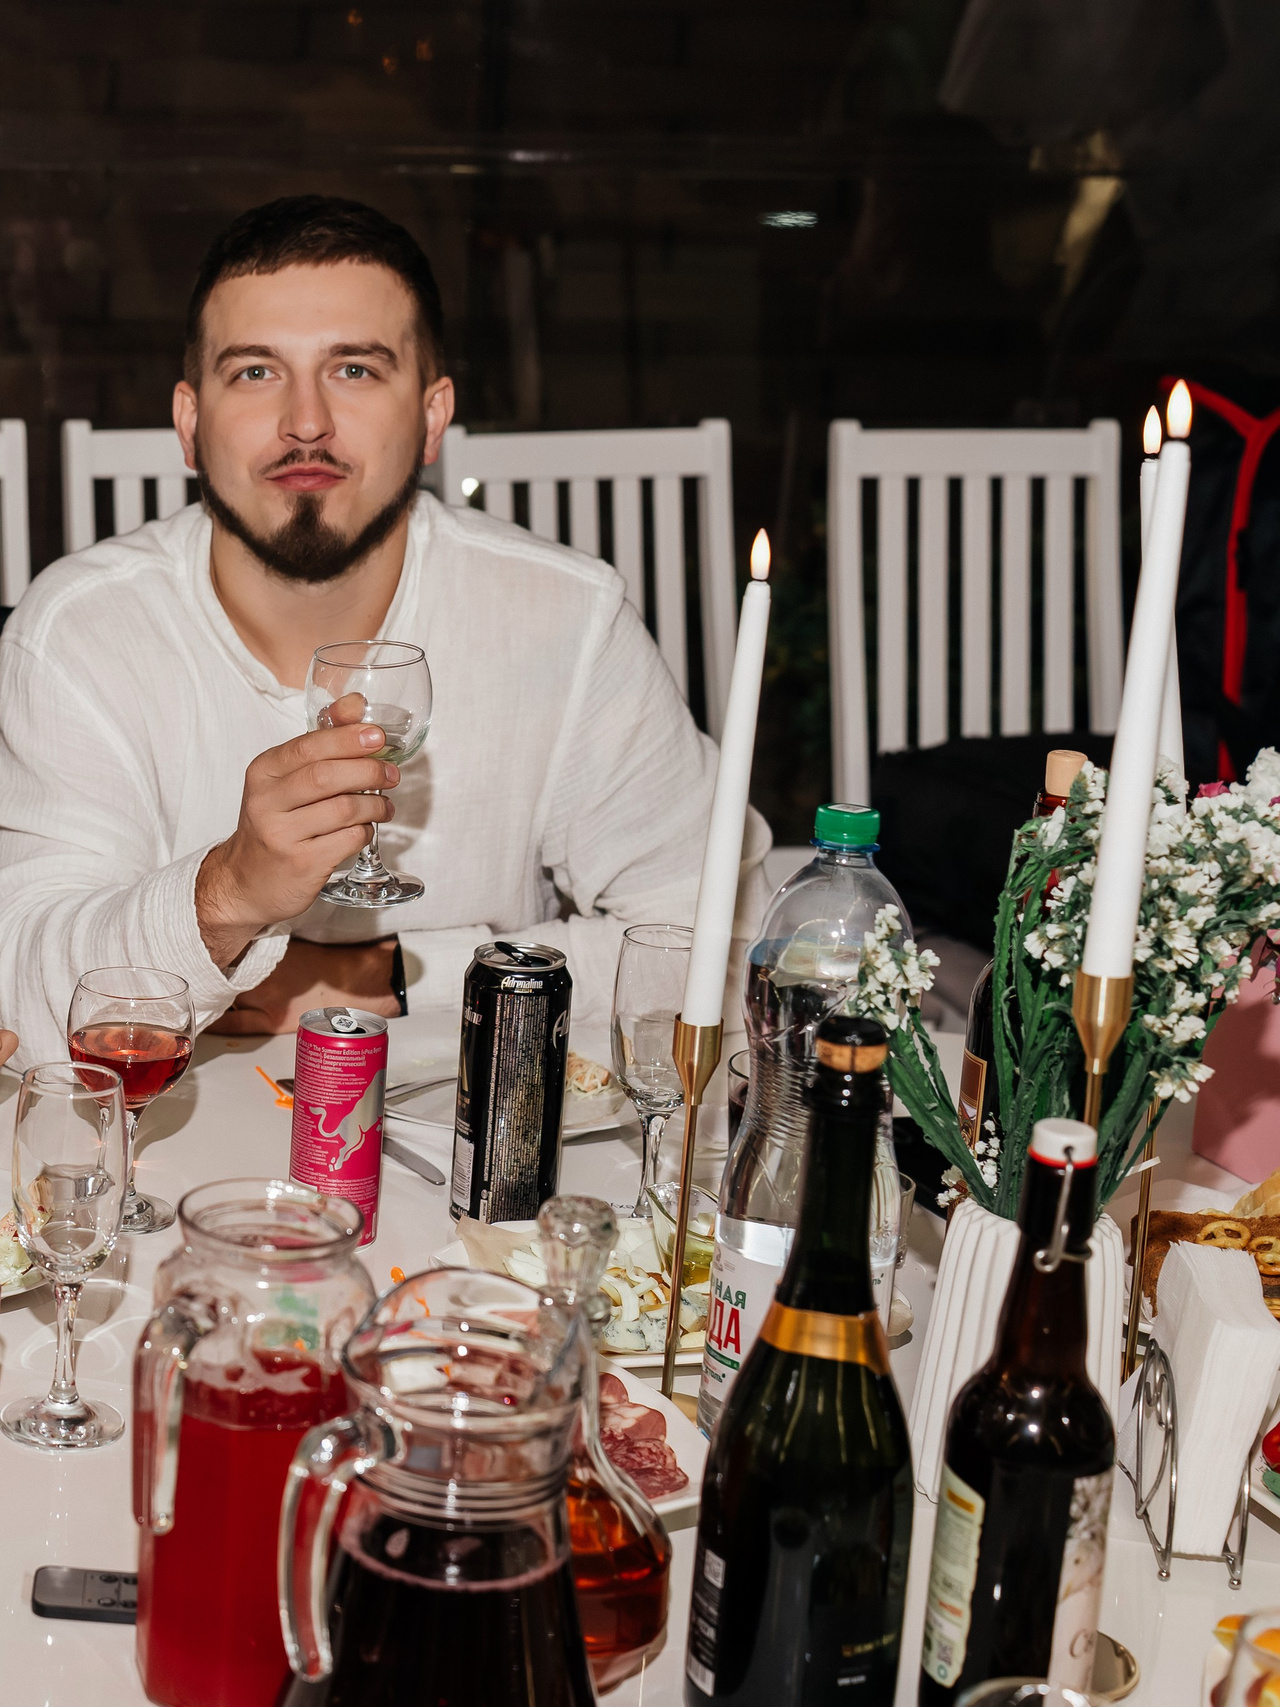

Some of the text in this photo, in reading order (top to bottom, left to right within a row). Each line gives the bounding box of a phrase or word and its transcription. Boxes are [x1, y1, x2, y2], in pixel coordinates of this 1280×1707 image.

[501, 976, 543, 990] Adrenaline
[321, 1046, 342, 1055] Summer
[708, 1297, 741, 1355] ДА
